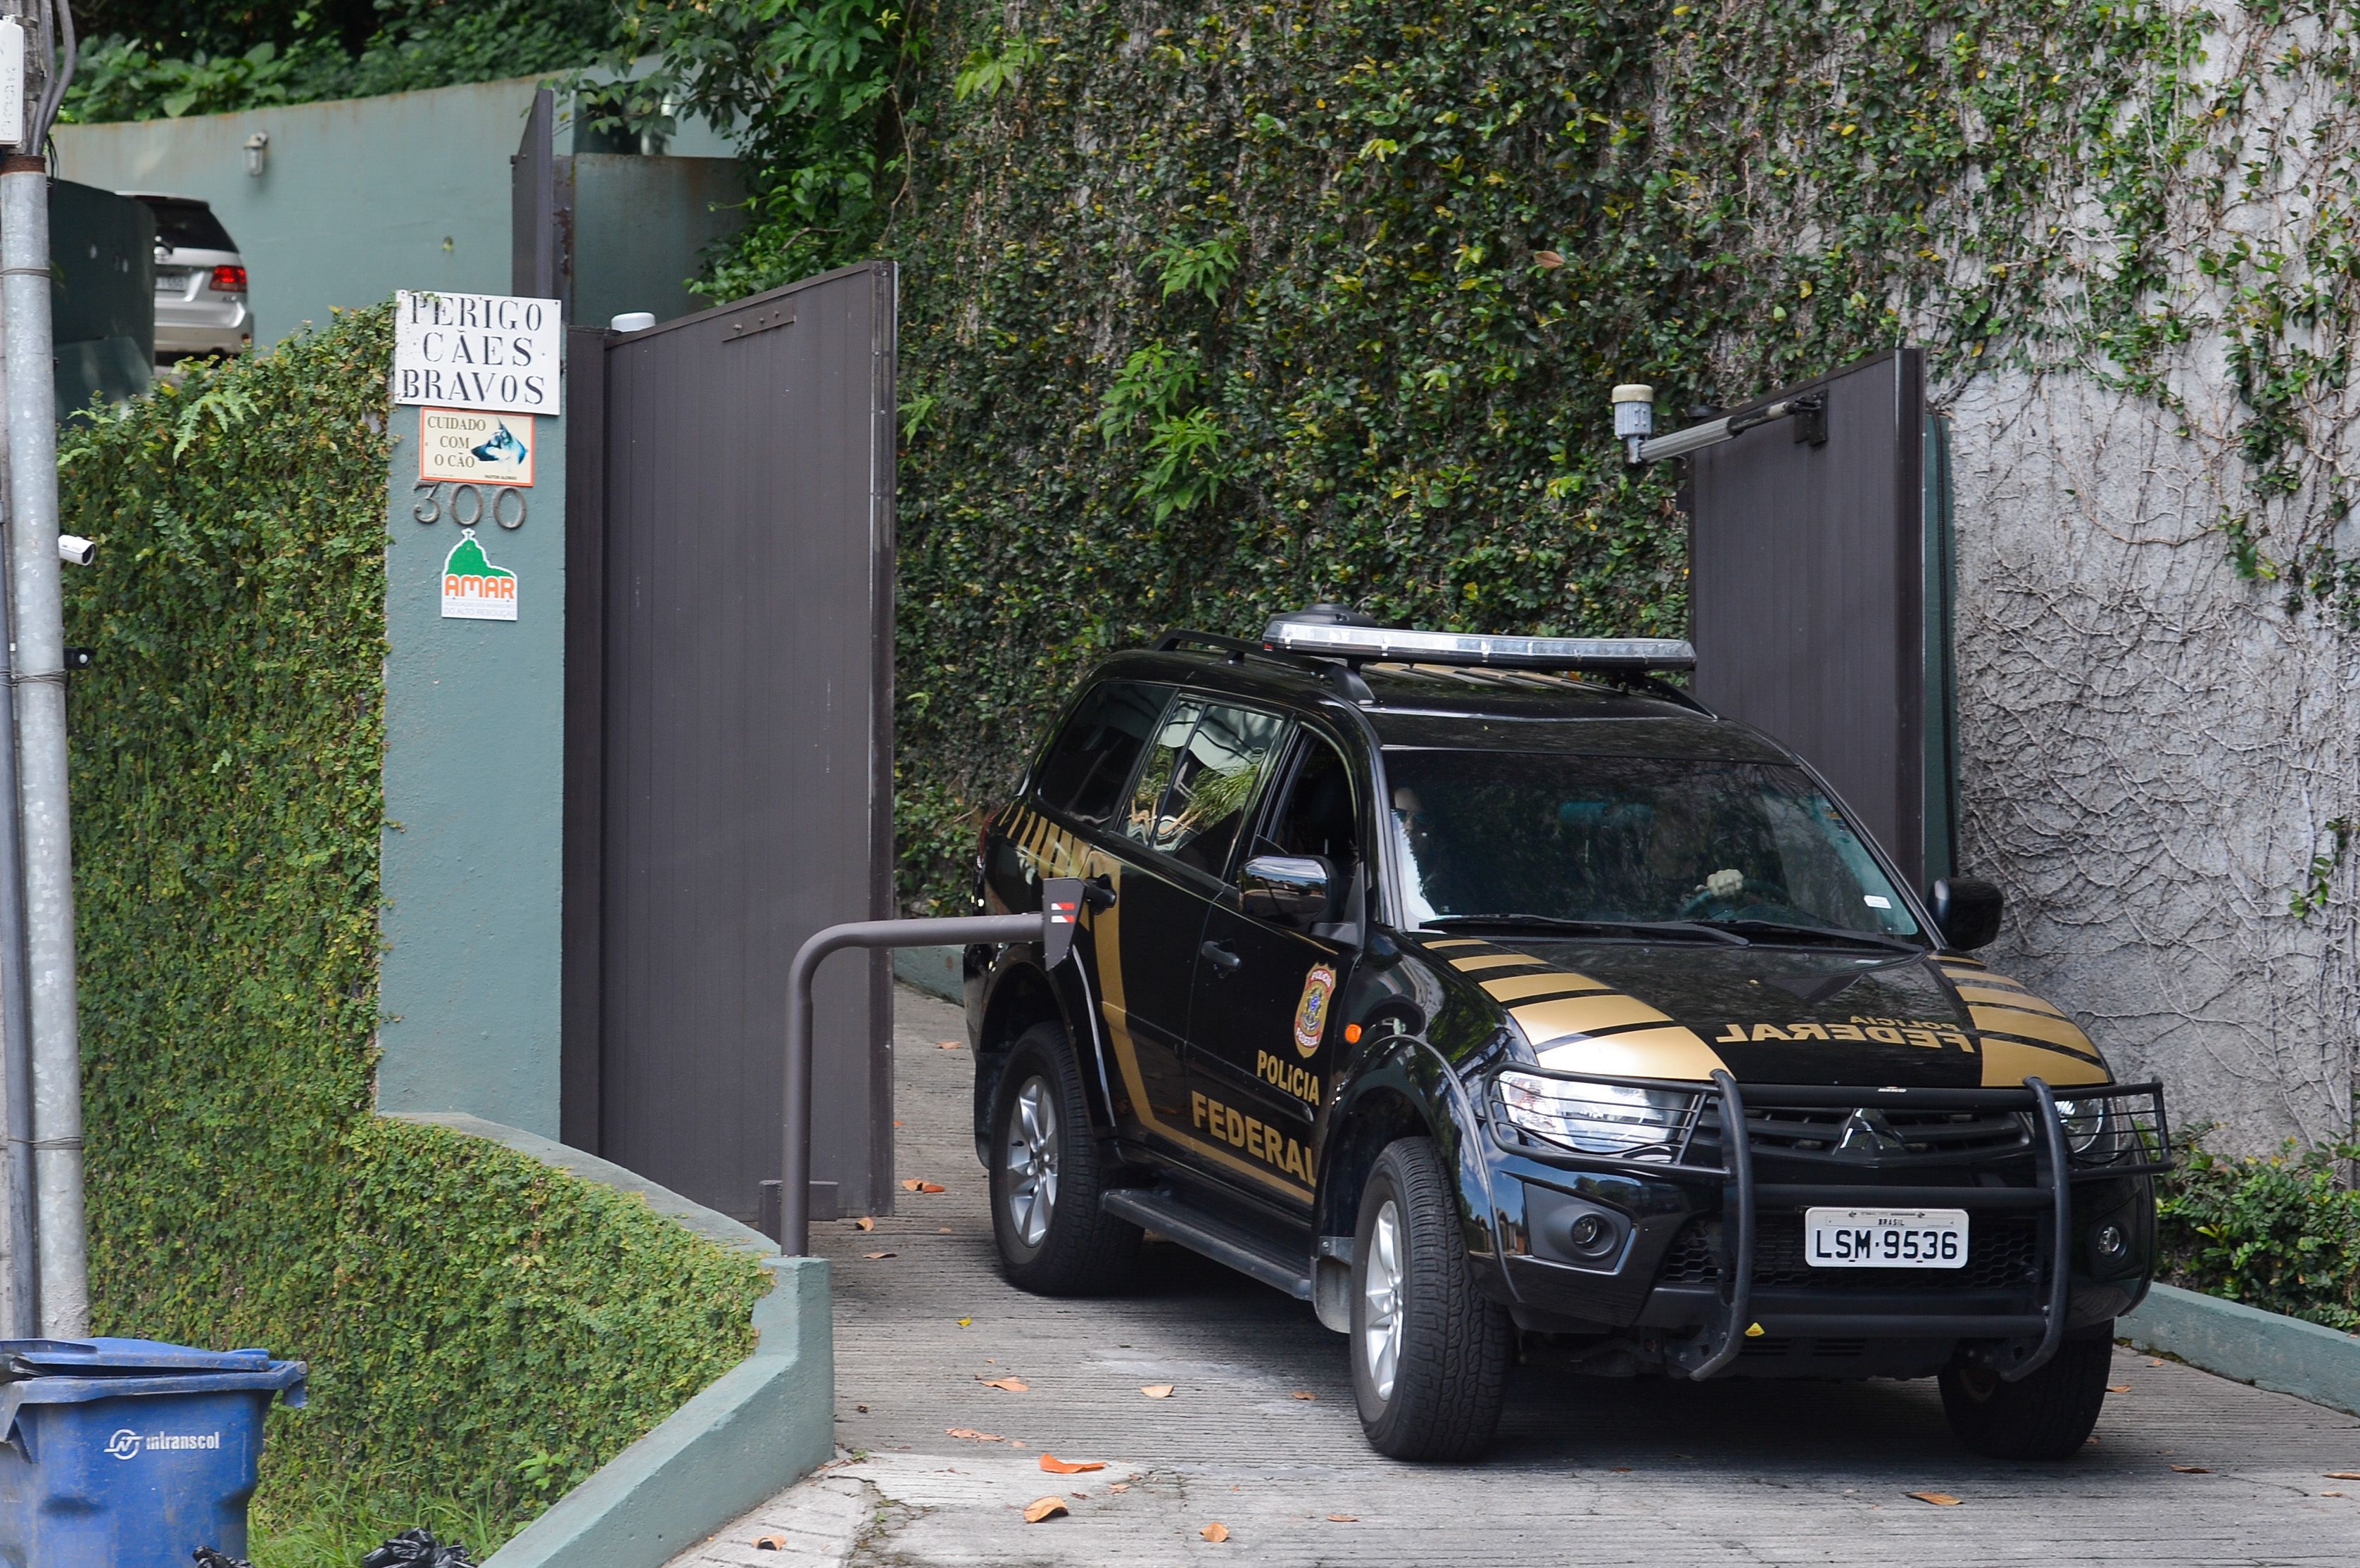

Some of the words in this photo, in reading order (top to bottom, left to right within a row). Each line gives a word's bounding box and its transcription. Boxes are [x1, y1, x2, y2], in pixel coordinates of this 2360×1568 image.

[408, 293, 542, 331] PERIGO
[423, 329, 533, 367] CÃES
[400, 369, 545, 405] BRAVOS
[427, 416, 486, 431] CUIDADO
[434, 454, 444, 466] O
[448, 453, 475, 468] CÃO
[440, 436, 469, 449] COM
[413, 480, 526, 529] 300
[444, 575, 515, 600] AMAR
[1192, 1091, 1317, 1187] FEDERAL
